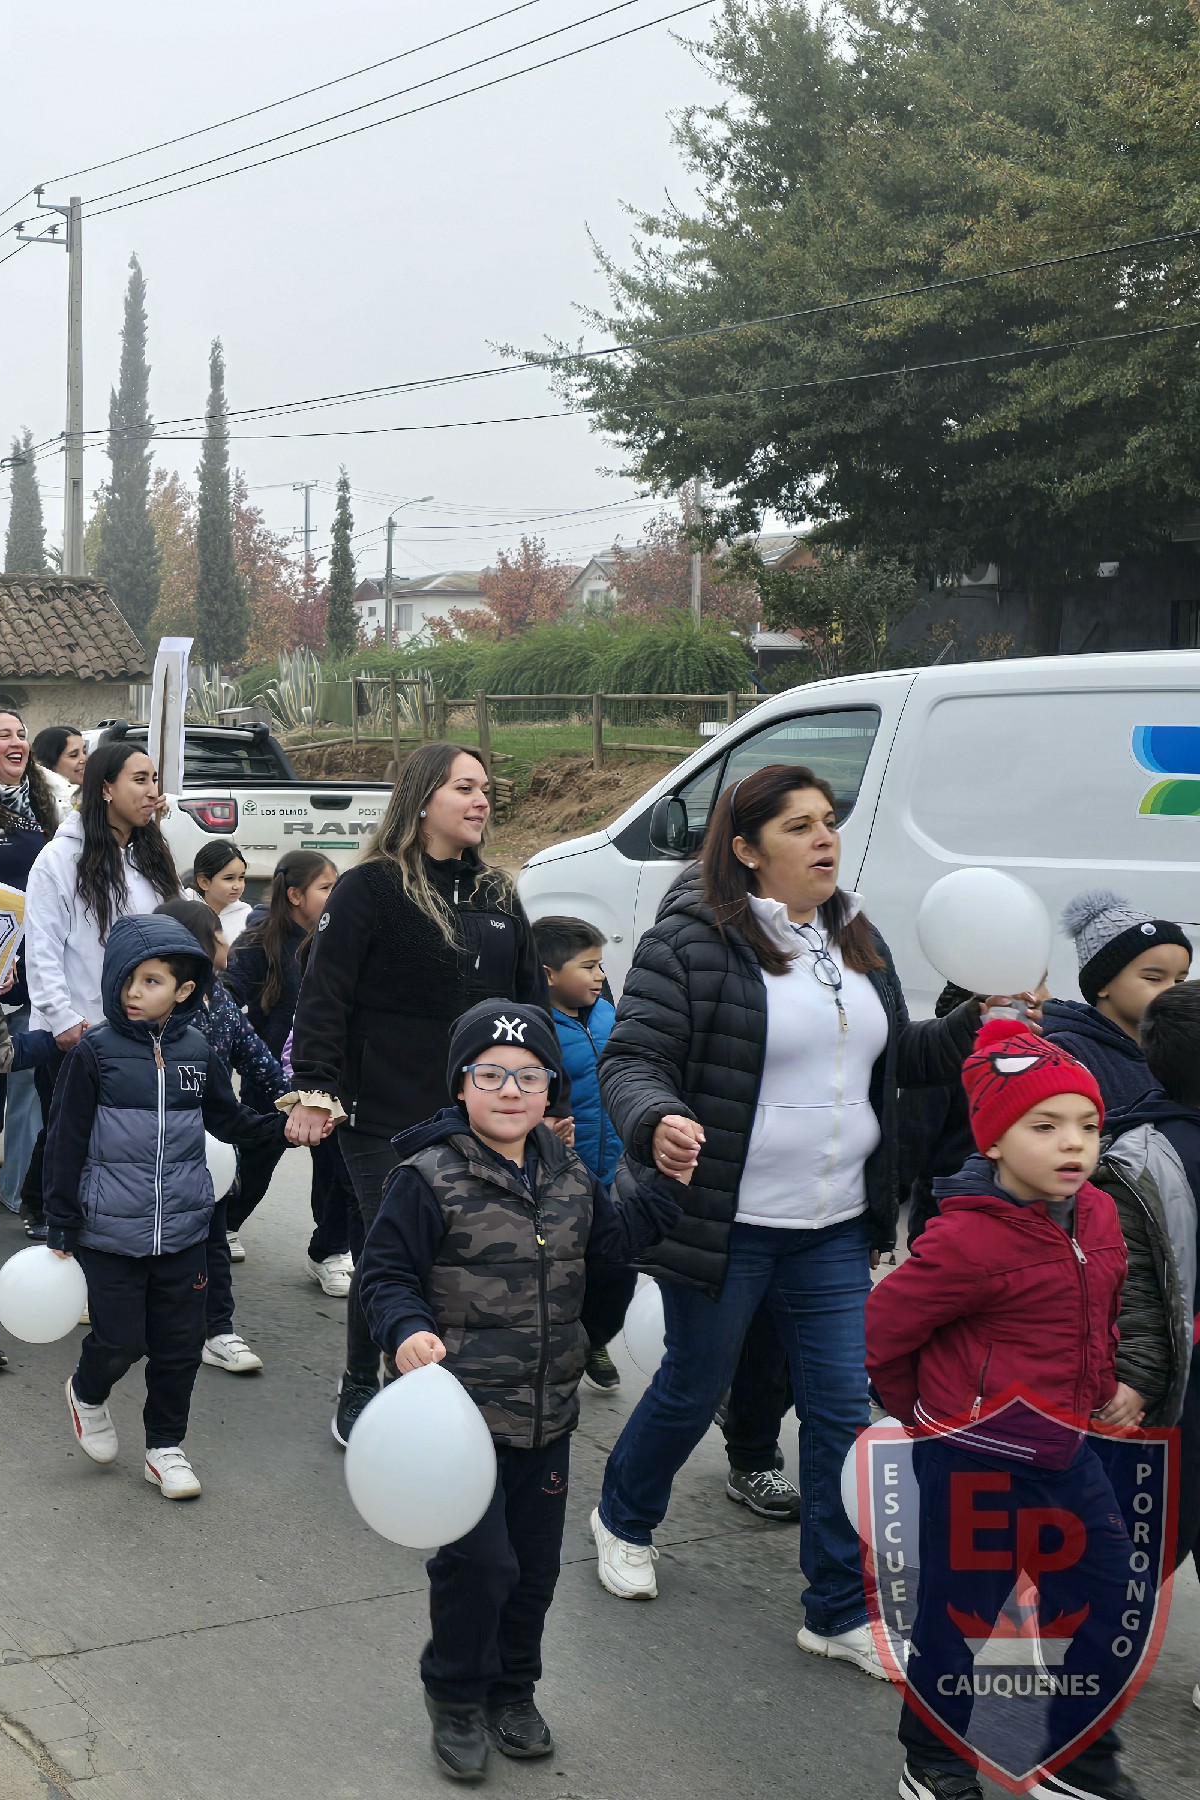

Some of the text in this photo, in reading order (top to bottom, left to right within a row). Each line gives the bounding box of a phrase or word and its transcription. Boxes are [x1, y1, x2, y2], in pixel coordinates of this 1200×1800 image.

[260, 808, 276, 816] LOS
[283, 820, 379, 835] RAM
[491, 1015, 528, 1043] NY
